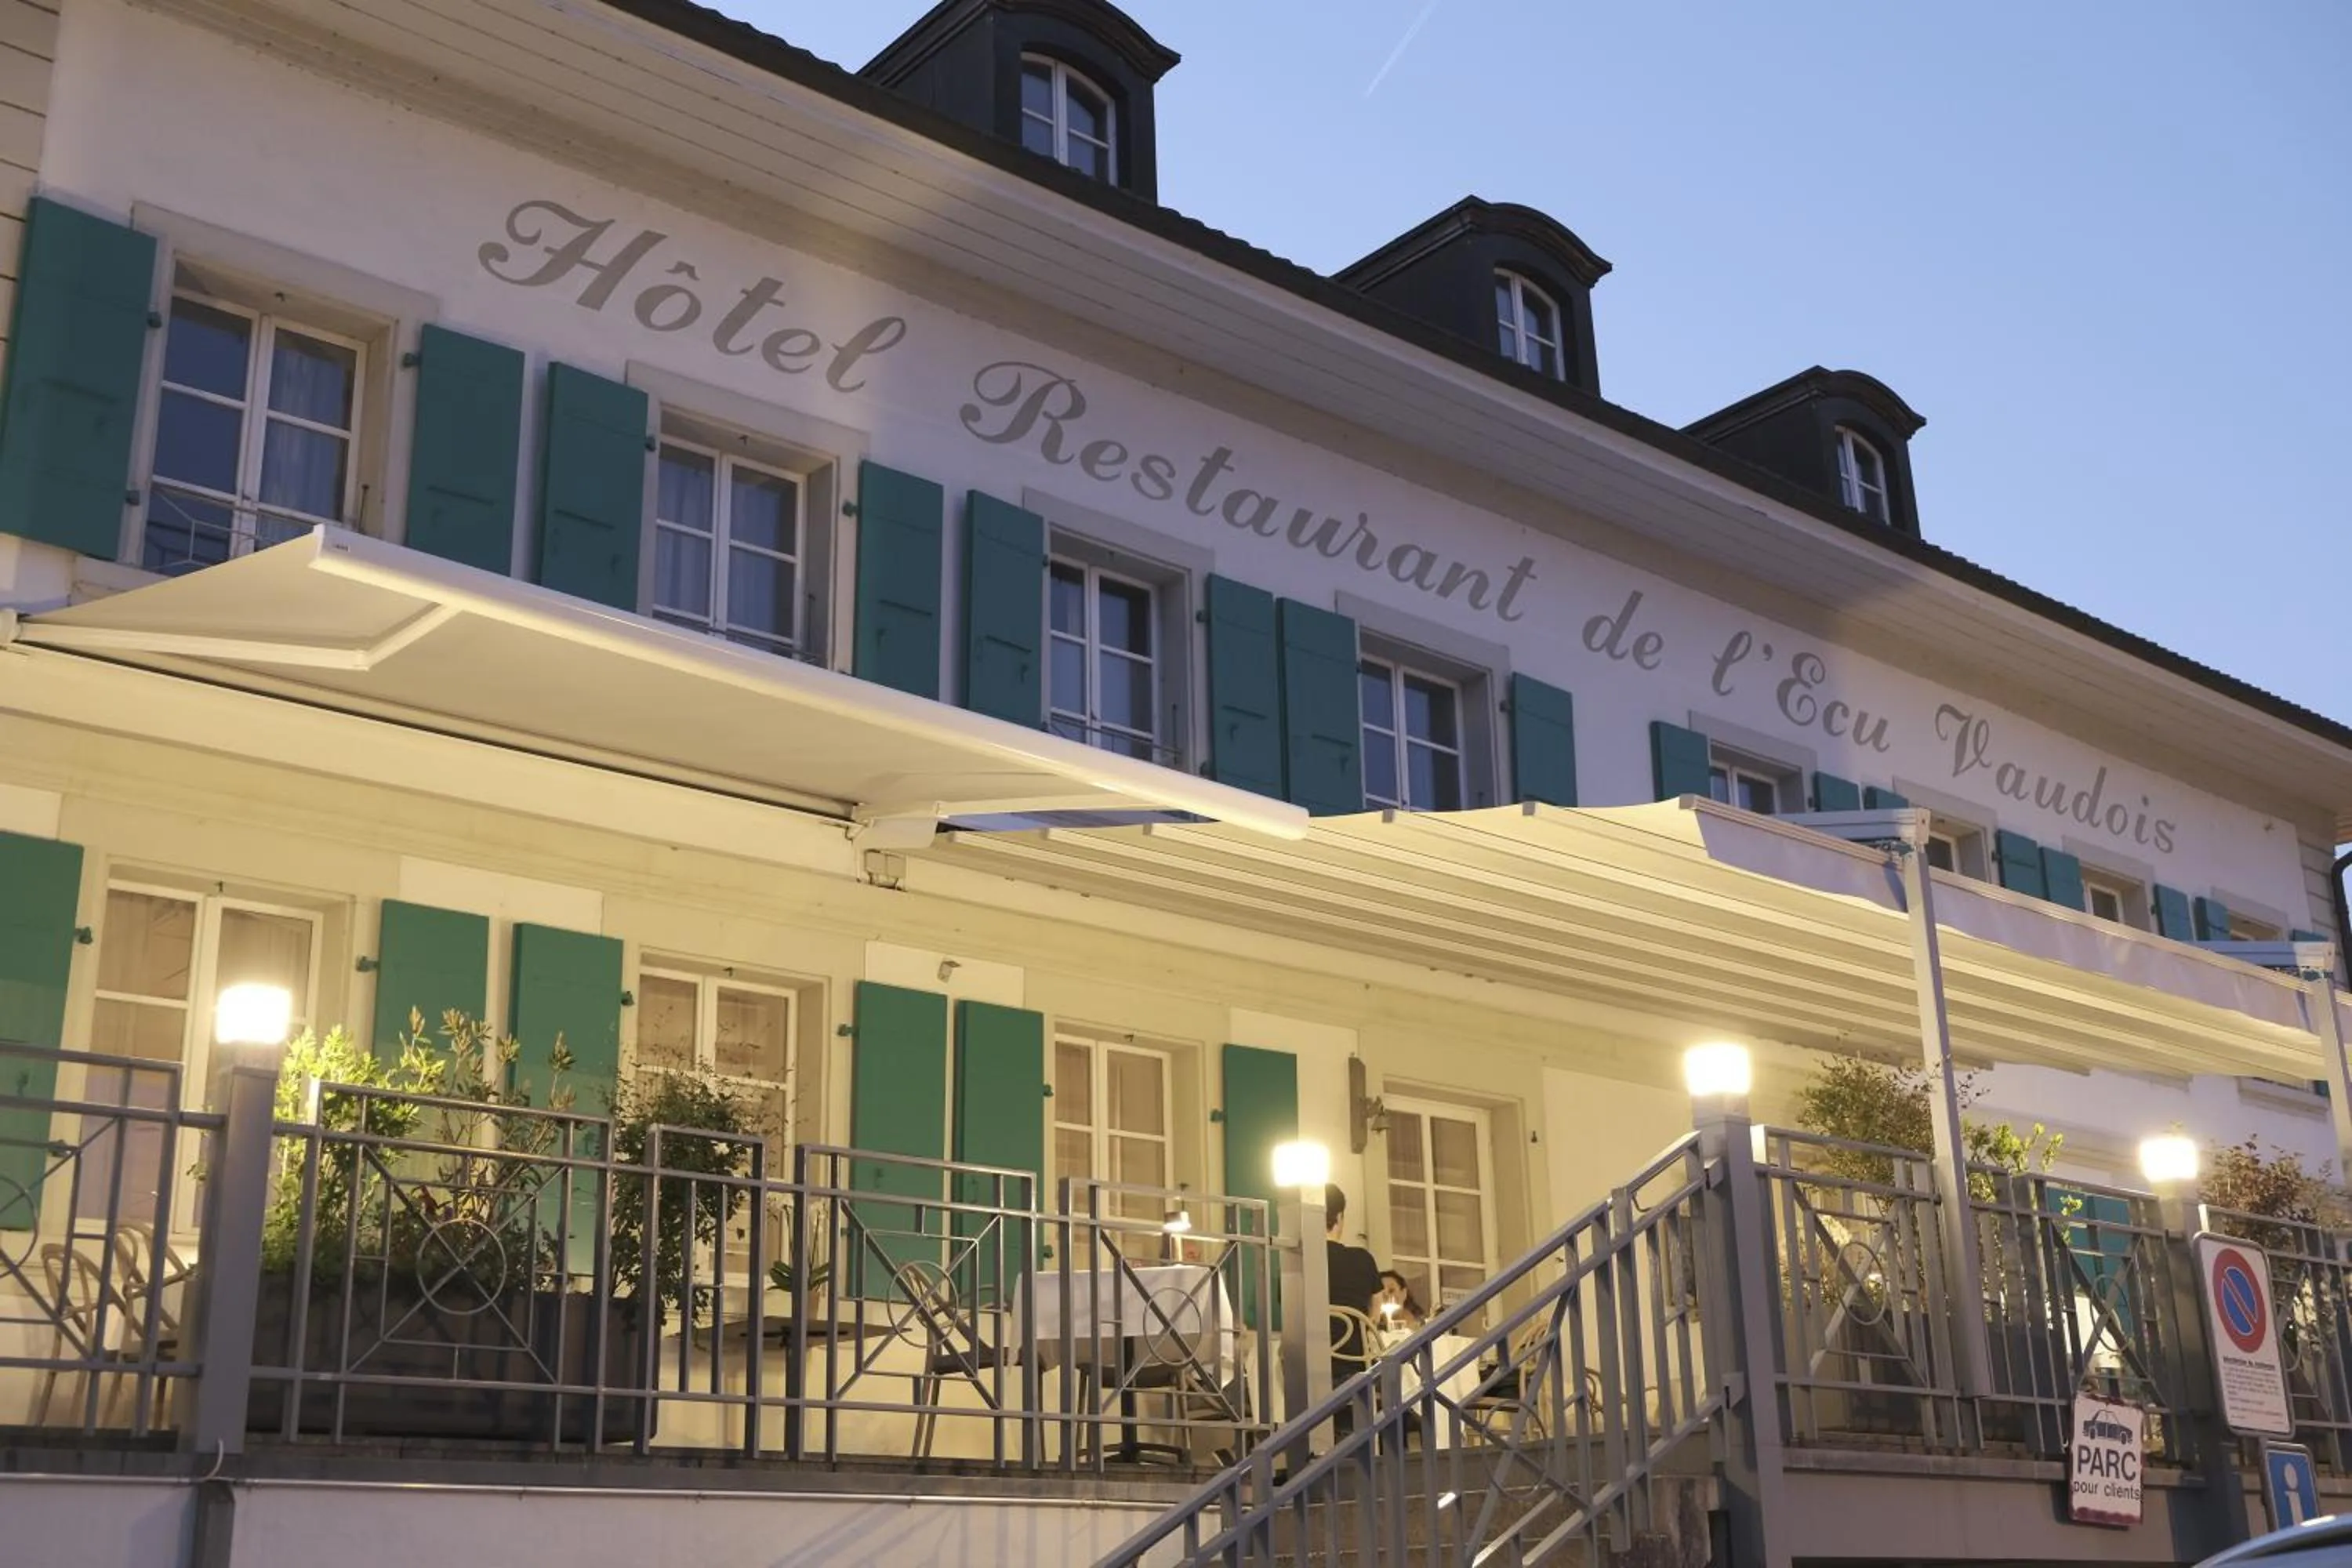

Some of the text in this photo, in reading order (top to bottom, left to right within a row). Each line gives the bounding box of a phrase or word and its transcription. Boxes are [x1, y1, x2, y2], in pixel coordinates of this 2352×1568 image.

[477, 200, 907, 393] Hôtel
[959, 361, 1538, 622] Restaurant
[1582, 590, 1664, 670] de
[1934, 702, 2176, 855] Vaudois
[2078, 1444, 2136, 1481] PARC
[2103, 1483, 2140, 1501] clients
